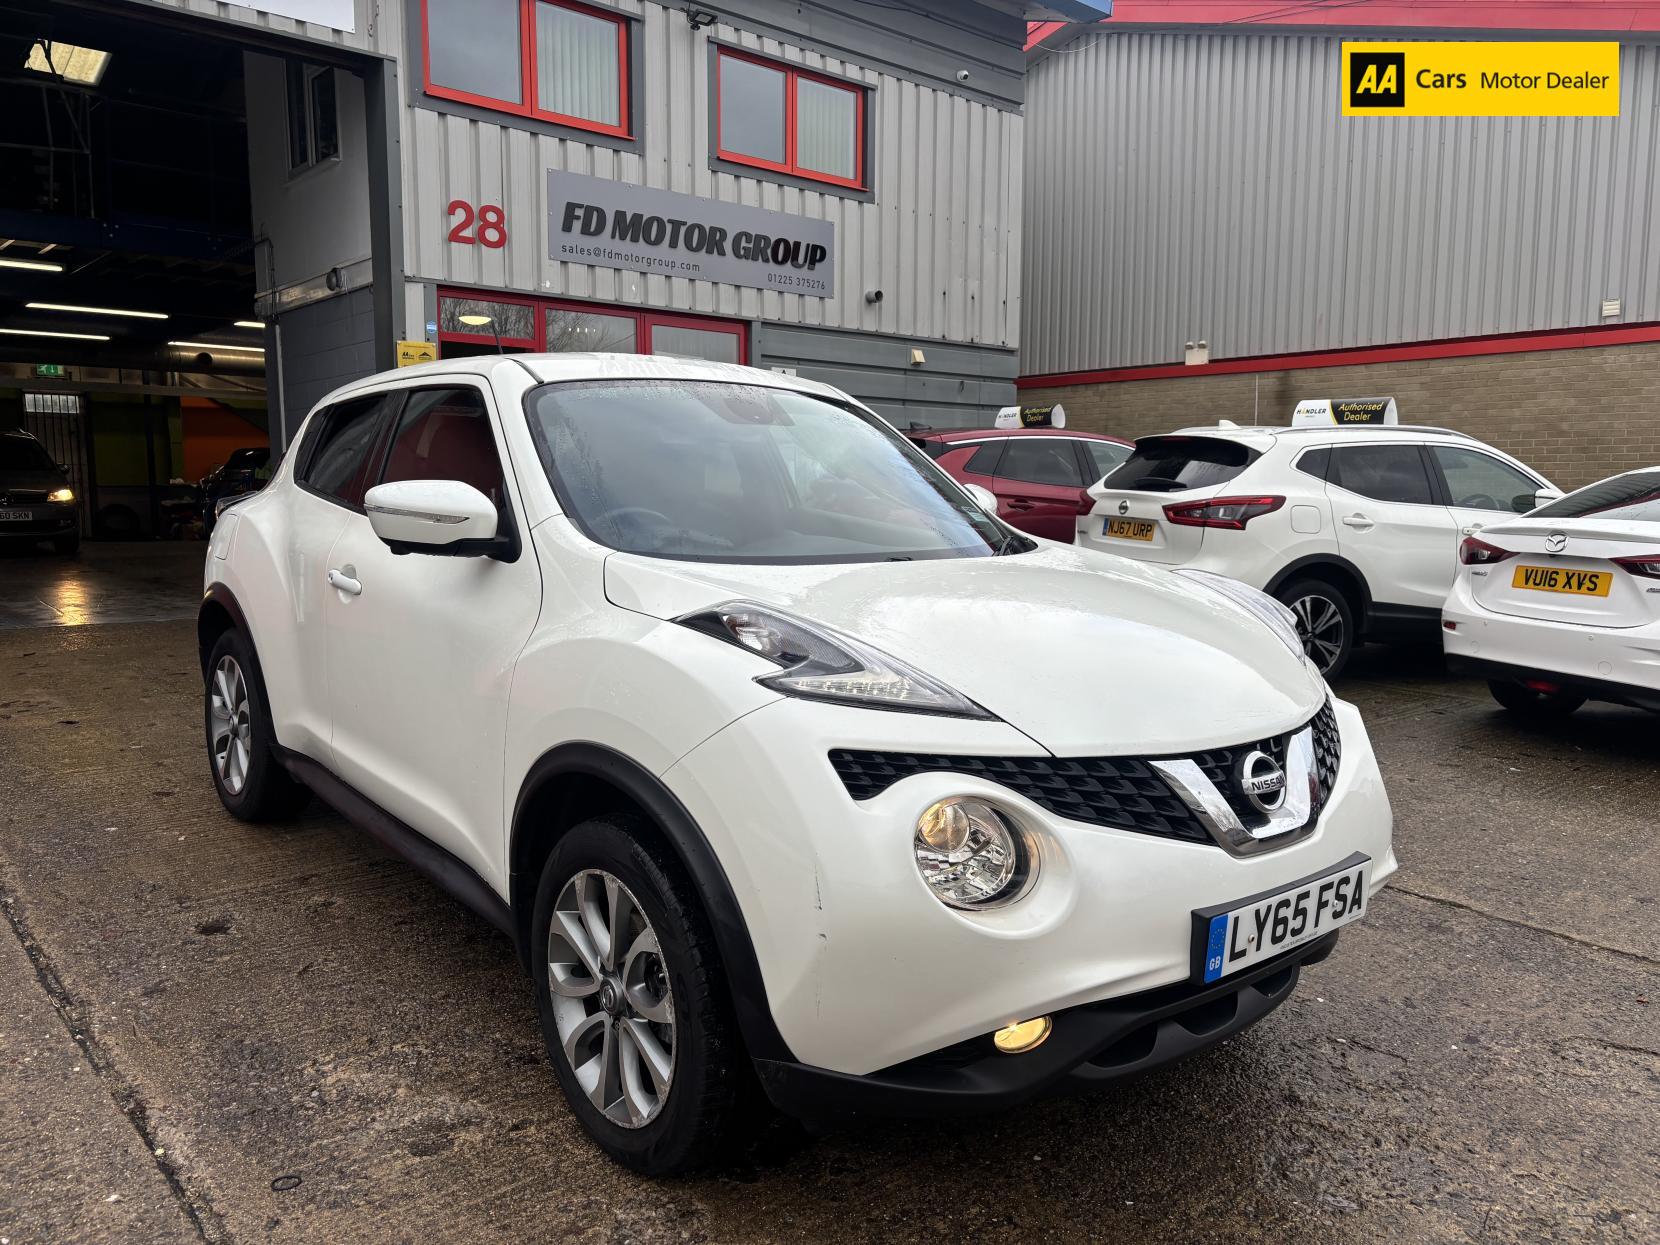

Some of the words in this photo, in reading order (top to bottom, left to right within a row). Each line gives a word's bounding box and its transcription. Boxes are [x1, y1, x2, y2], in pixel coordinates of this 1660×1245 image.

[447, 200, 507, 249] 28
[561, 201, 607, 236] FD
[610, 209, 728, 256] MOTOR
[731, 230, 827, 271] GROUP
[561, 243, 700, 272] sales@fdmotorgroup.com
[767, 273, 793, 285] 01225
[1338, 401, 1384, 412] Authorised
[1344, 411, 1371, 421] Dealer
[1108, 519, 1132, 535] NJ67
[1132, 523, 1153, 538] URP
[1562, 572, 1600, 592] XVS
[1251, 775, 1285, 791] NISSAN
[1228, 890, 1310, 963] LY65
[1314, 870, 1364, 929] FSA
[1209, 961, 1221, 970] GB
